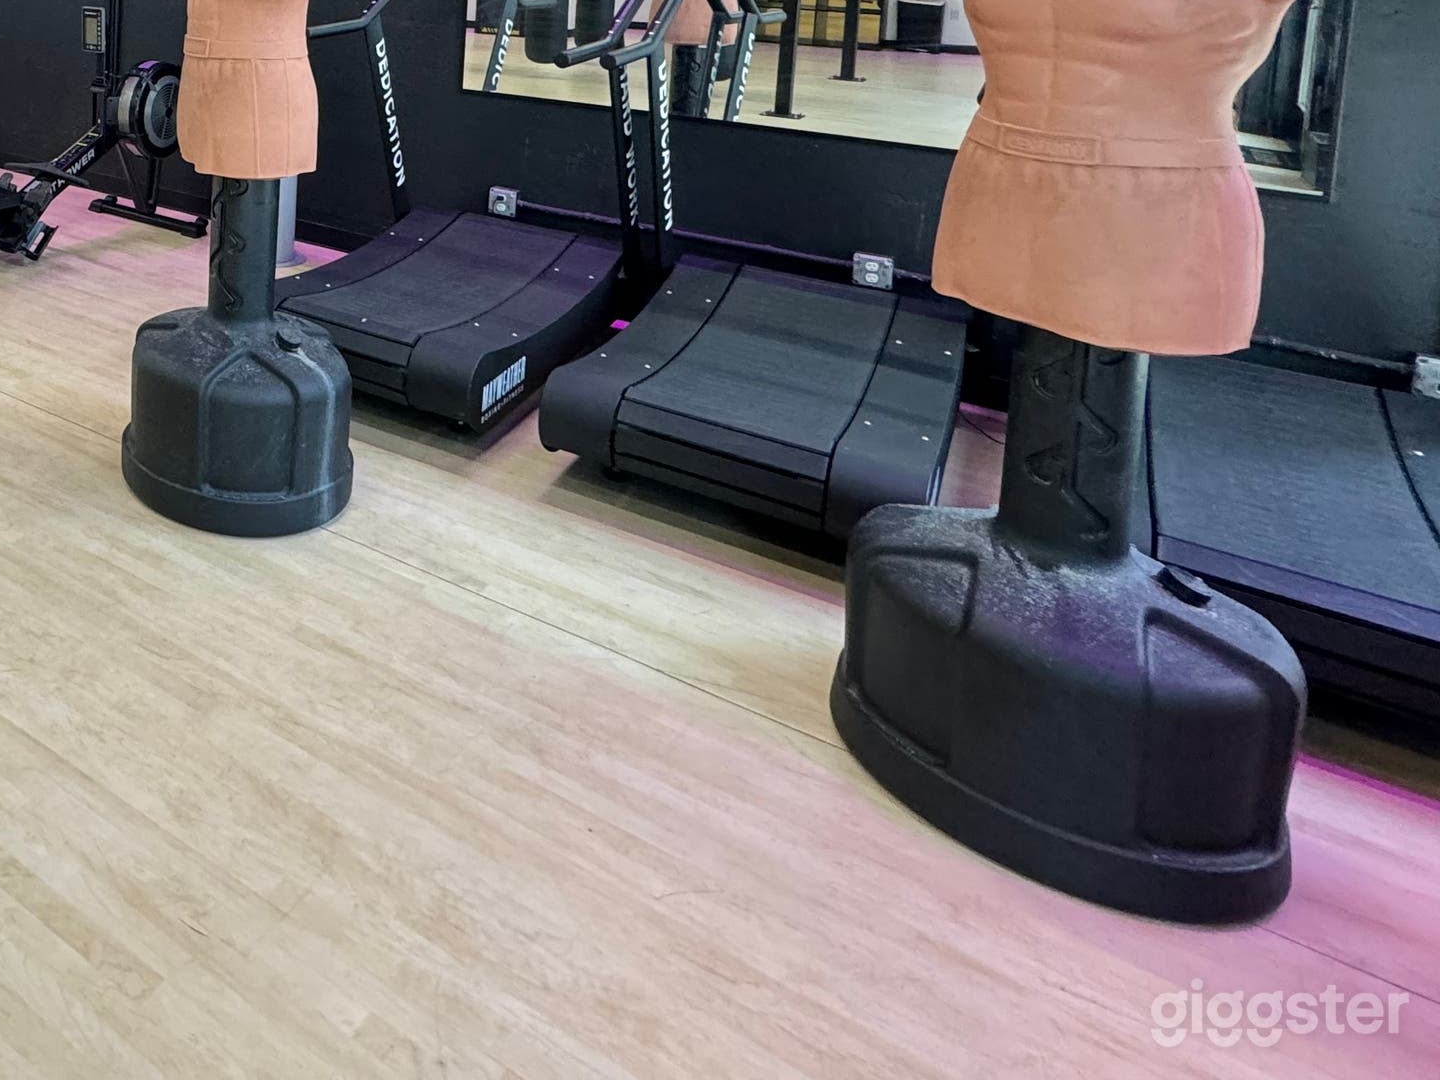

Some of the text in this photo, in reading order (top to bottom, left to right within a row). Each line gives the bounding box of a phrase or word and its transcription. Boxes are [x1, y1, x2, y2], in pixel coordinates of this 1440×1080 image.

[375, 37, 406, 188] DEDICATION
[658, 59, 673, 232] DEDICATION
[481, 355, 527, 413] MAYWEATHER
